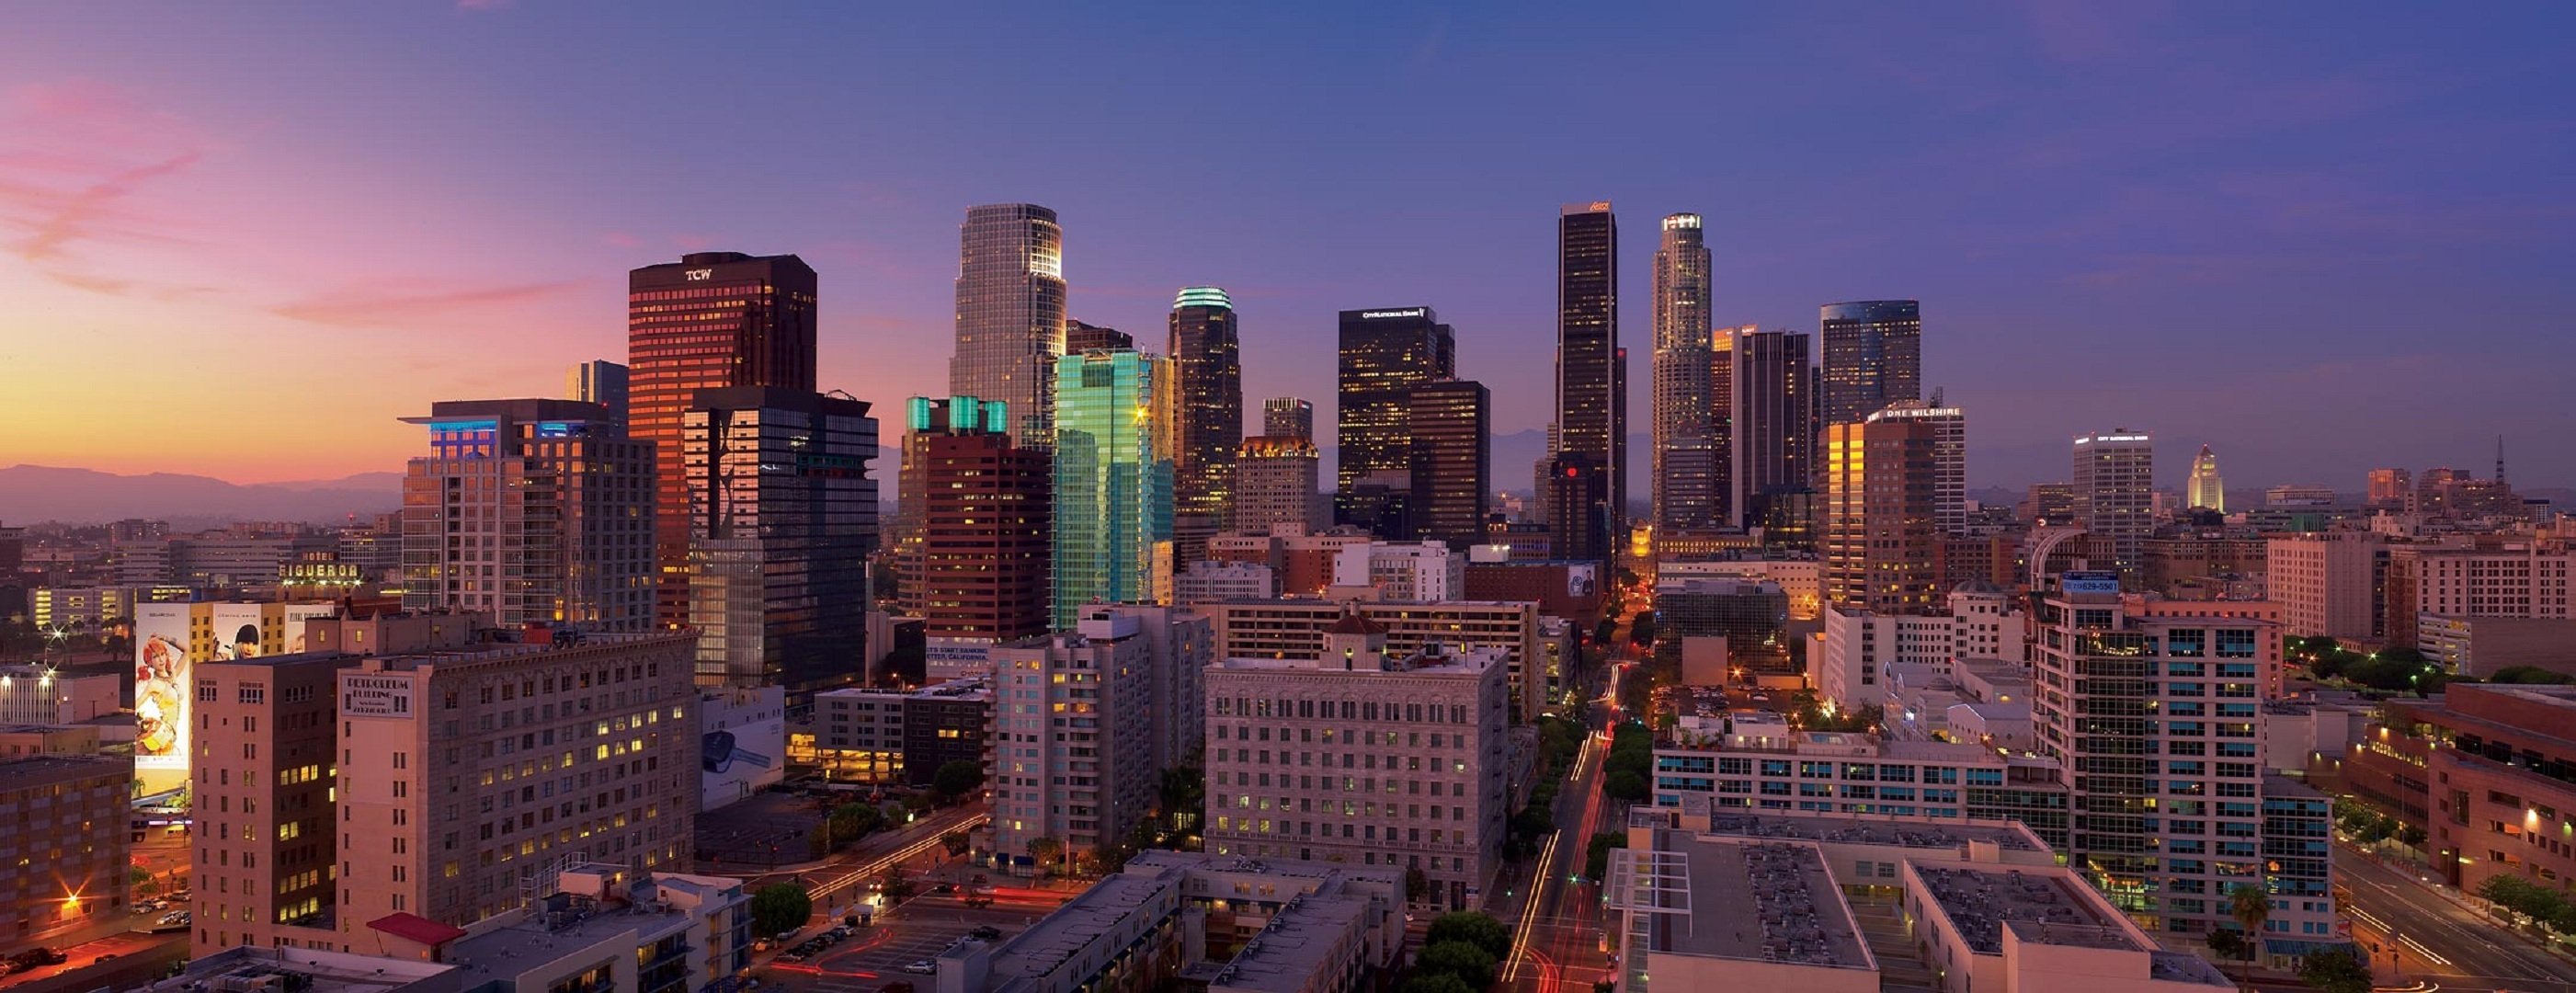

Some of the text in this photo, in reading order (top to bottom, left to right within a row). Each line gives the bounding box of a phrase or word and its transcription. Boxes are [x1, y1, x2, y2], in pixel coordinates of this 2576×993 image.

[685, 268, 712, 280] TCW
[1911, 407, 1960, 417] WILSHIRE
[302, 552, 335, 561] HOTEL
[279, 565, 358, 576] FIGUEROA
[348, 679, 408, 690] PETROLEUM
[353, 690, 393, 699] BUILDING
